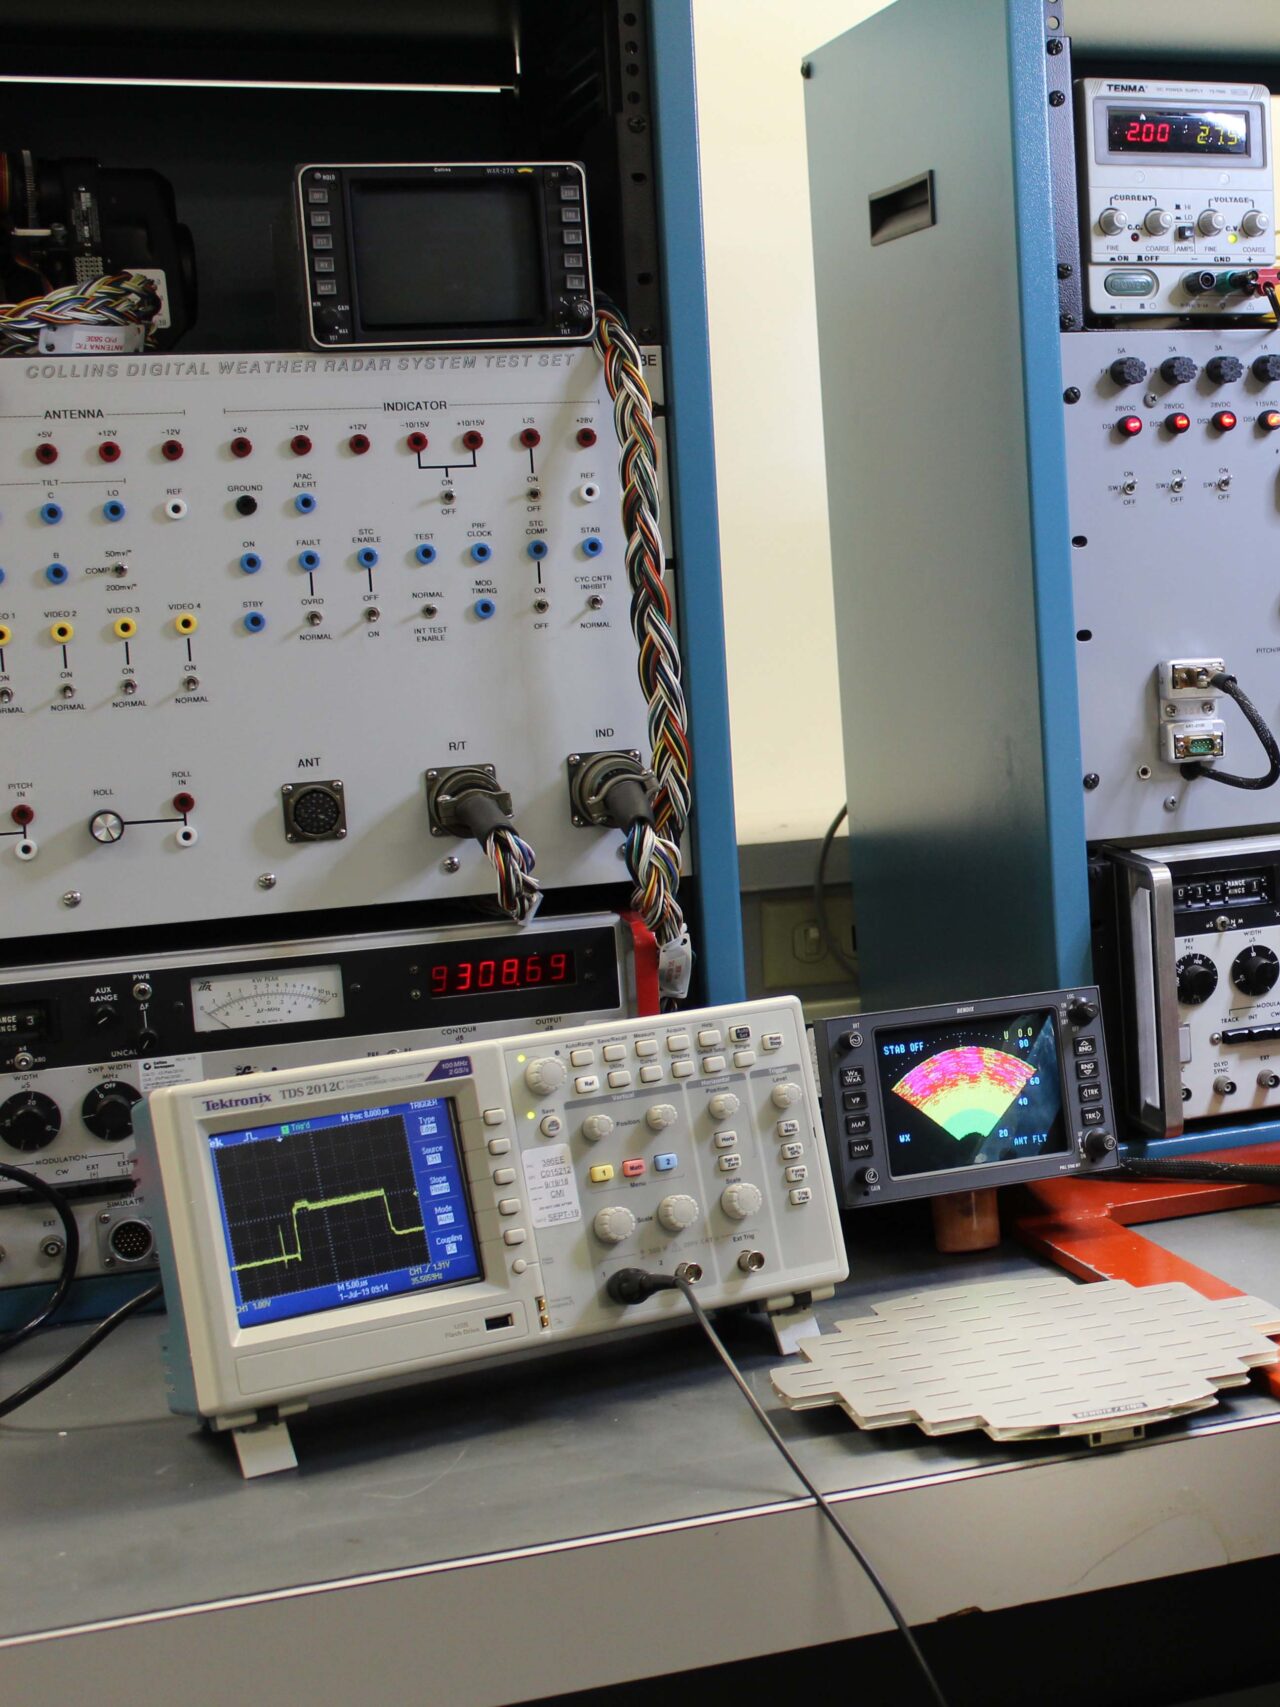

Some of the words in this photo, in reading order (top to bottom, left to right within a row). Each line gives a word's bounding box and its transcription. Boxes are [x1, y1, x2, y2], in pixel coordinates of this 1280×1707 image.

[1107, 84, 1145, 93] TENMA
[1127, 122, 1171, 142] 2.00
[1114, 194, 1153, 202] CURRENT
[1214, 196, 1249, 204] VOLTAGE
[25, 364, 118, 380] COLLINS
[126, 361, 210, 376] DIGITAL
[217, 360, 317, 375] WEATHER
[324, 358, 390, 372] RADAR
[399, 356, 476, 370] SYSTEM
[484, 354, 532, 368] TEST
[538, 354, 575, 367] SET
[383, 401, 448, 412] INDICATOR
[44, 409, 104, 420] ANTENNA
[227, 484, 263, 492] GROUND
[112, 700, 147, 708] NORMAL
[175, 696, 209, 704] NORMAL
[50, 704, 85, 712] NORMAL
[595, 727, 614, 738] IND
[448, 741, 466, 751] R/T
[298, 757, 321, 768] ANT
[93, 788, 114, 796] ROLL
[90, 994, 118, 1003] RANGE
[535, 1017, 562, 1026] OUTPUT
[441, 1026, 477, 1036] CONTOUR
[1017, 1027, 1033, 1038] 0.0
[1018, 1038, 1029, 1048] 80
[111, 1049, 137, 1057] UNCAL
[883, 1044, 906, 1056] STAB
[910, 1041, 924, 1053] OFF
[108, 1063, 132, 1071] WIDTH
[1080, 1063, 1094, 1071] RNG
[13, 1073, 38, 1081] WIDTH
[701, 1076, 730, 1086] Horizontal
[1030, 1076, 1040, 1087] 60
[202, 1092, 272, 1112] Tektronix
[279, 1087, 305, 1100] TDS
[306, 1081, 345, 1097] 2012C
[612, 1092, 635, 1101] Vertical
[410, 1098, 438, 1110] TRIGGER
[1018, 1097, 1028, 1107] 40
[418, 1115, 436, 1126] Type
[616, 1119, 640, 1127] Position
[851, 1120, 866, 1129] MAP
[899, 1133, 911, 1143] WX
[998, 1128, 1009, 1138] 20
[1014, 1136, 1028, 1146] ANT
[1032, 1133, 1048, 1143] FLT
[421, 1144, 443, 1154] Source
[854, 1144, 869, 1152] NAV
[35, 1154, 88, 1166] MODULATION
[430, 1174, 448, 1186] Slope
[434, 1204, 452, 1214] Mode
[436, 1233, 462, 1246] Coupling
